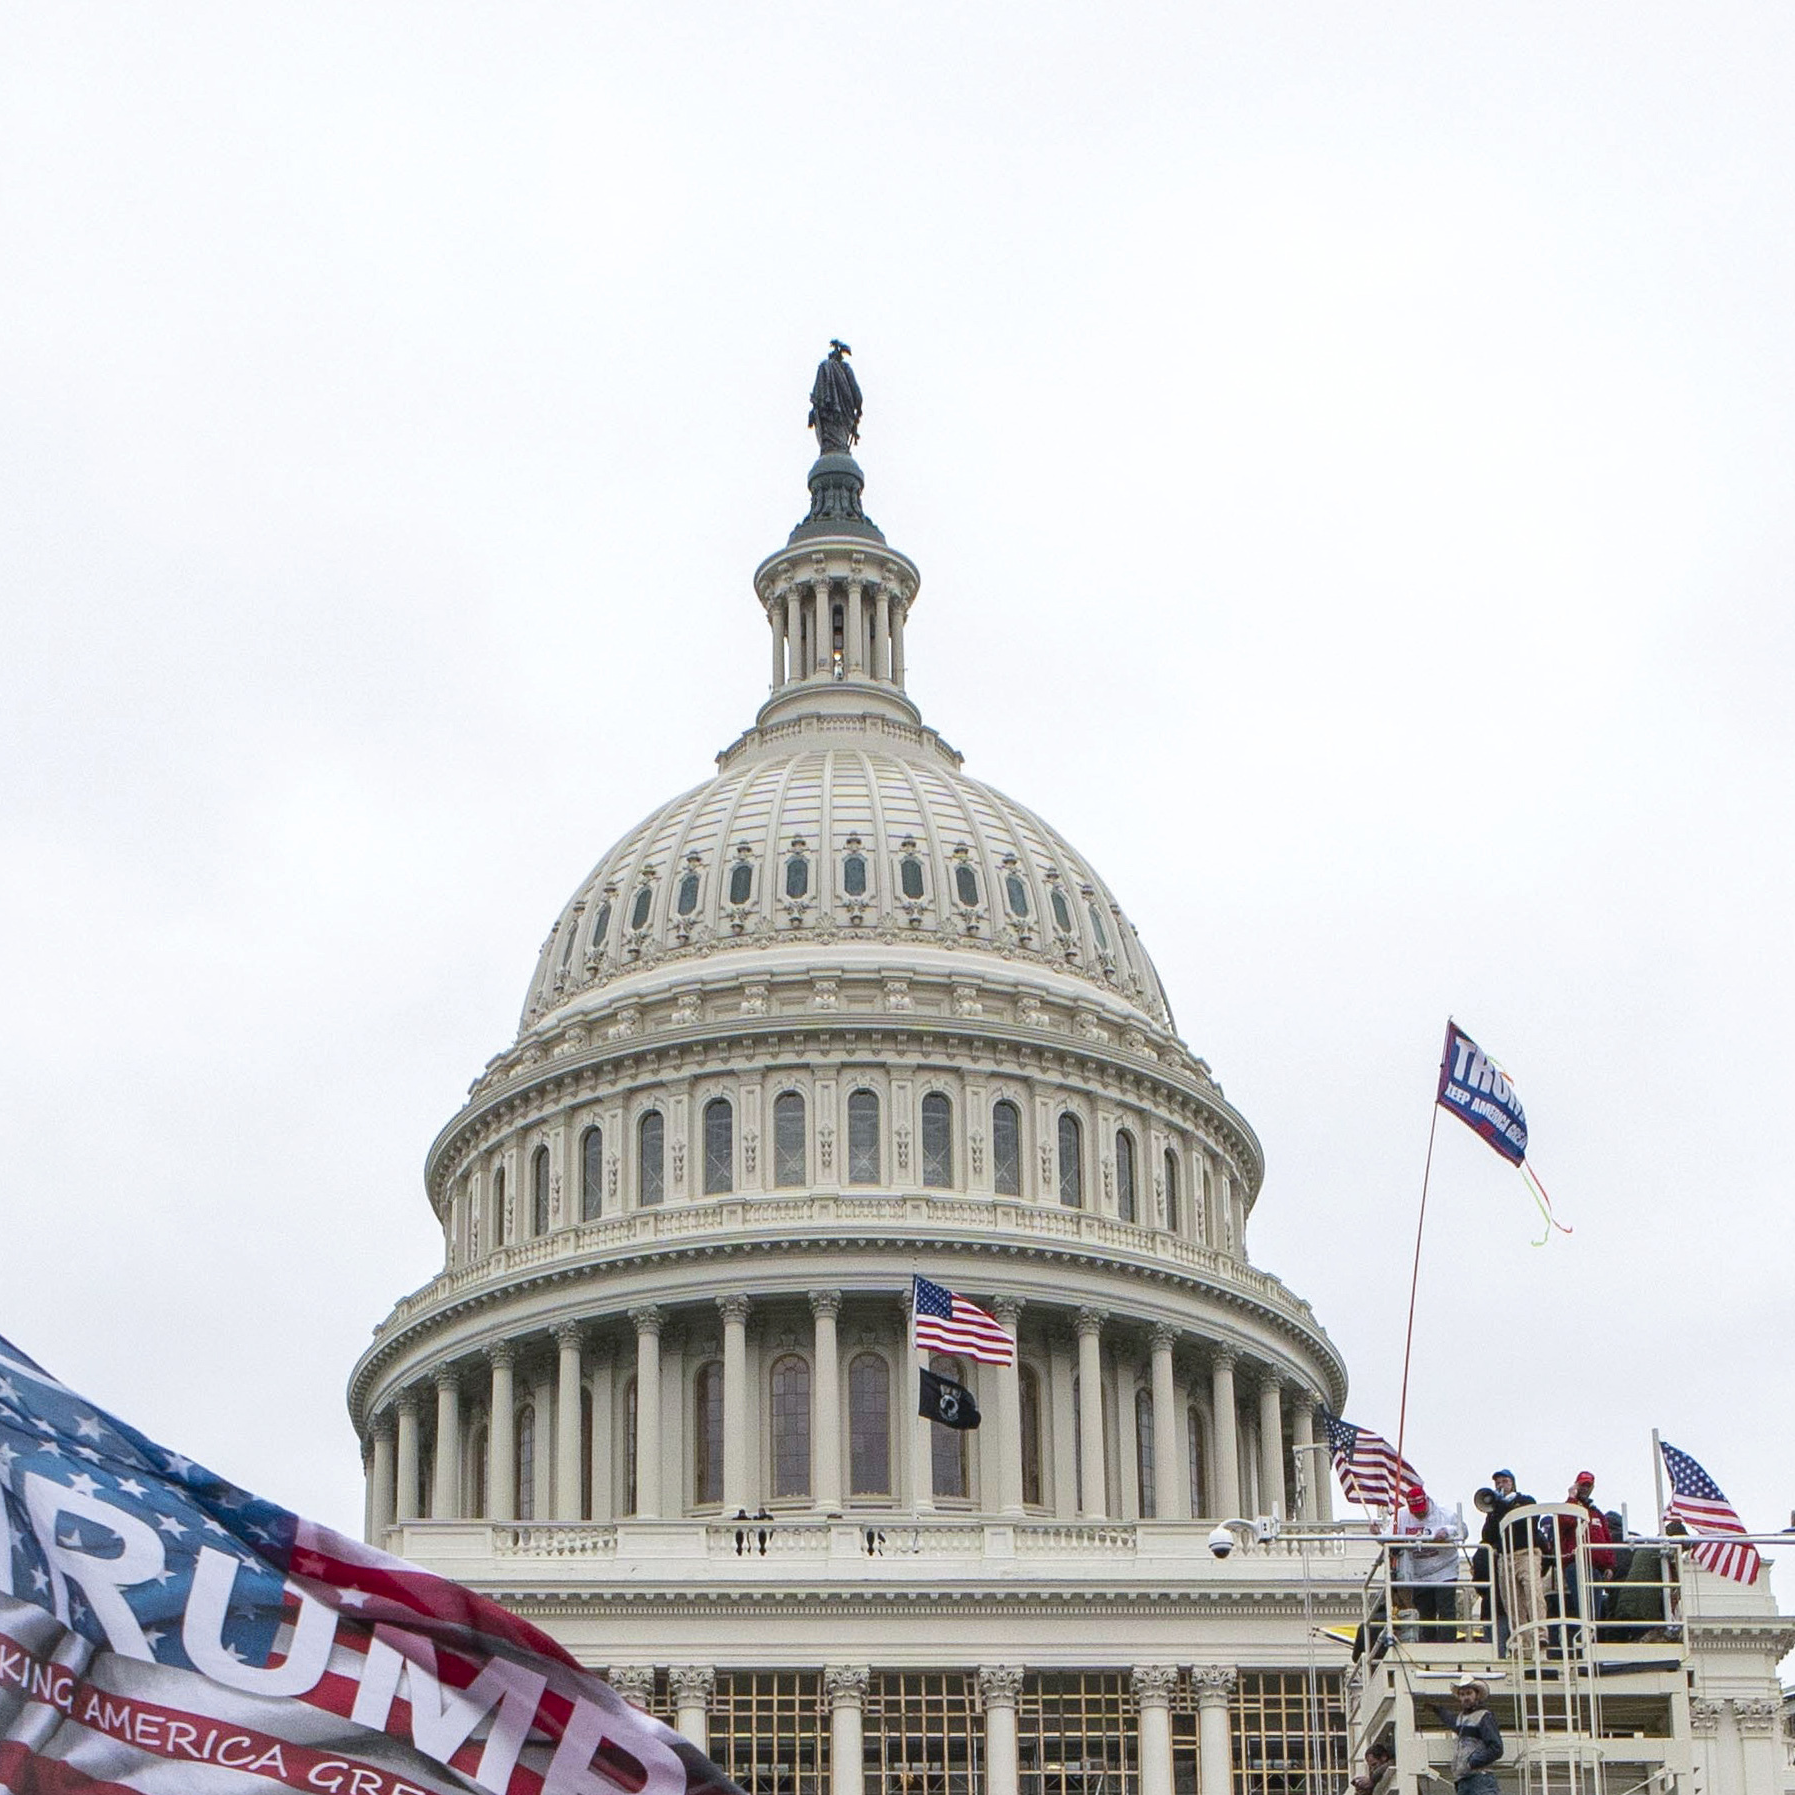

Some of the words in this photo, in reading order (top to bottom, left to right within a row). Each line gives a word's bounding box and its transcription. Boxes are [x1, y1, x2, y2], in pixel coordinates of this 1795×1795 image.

[1455, 1036, 1525, 1123] TRUM
[1471, 1096, 1506, 1134] AMERICA
[85, 1693, 290, 1780] AMERICA
